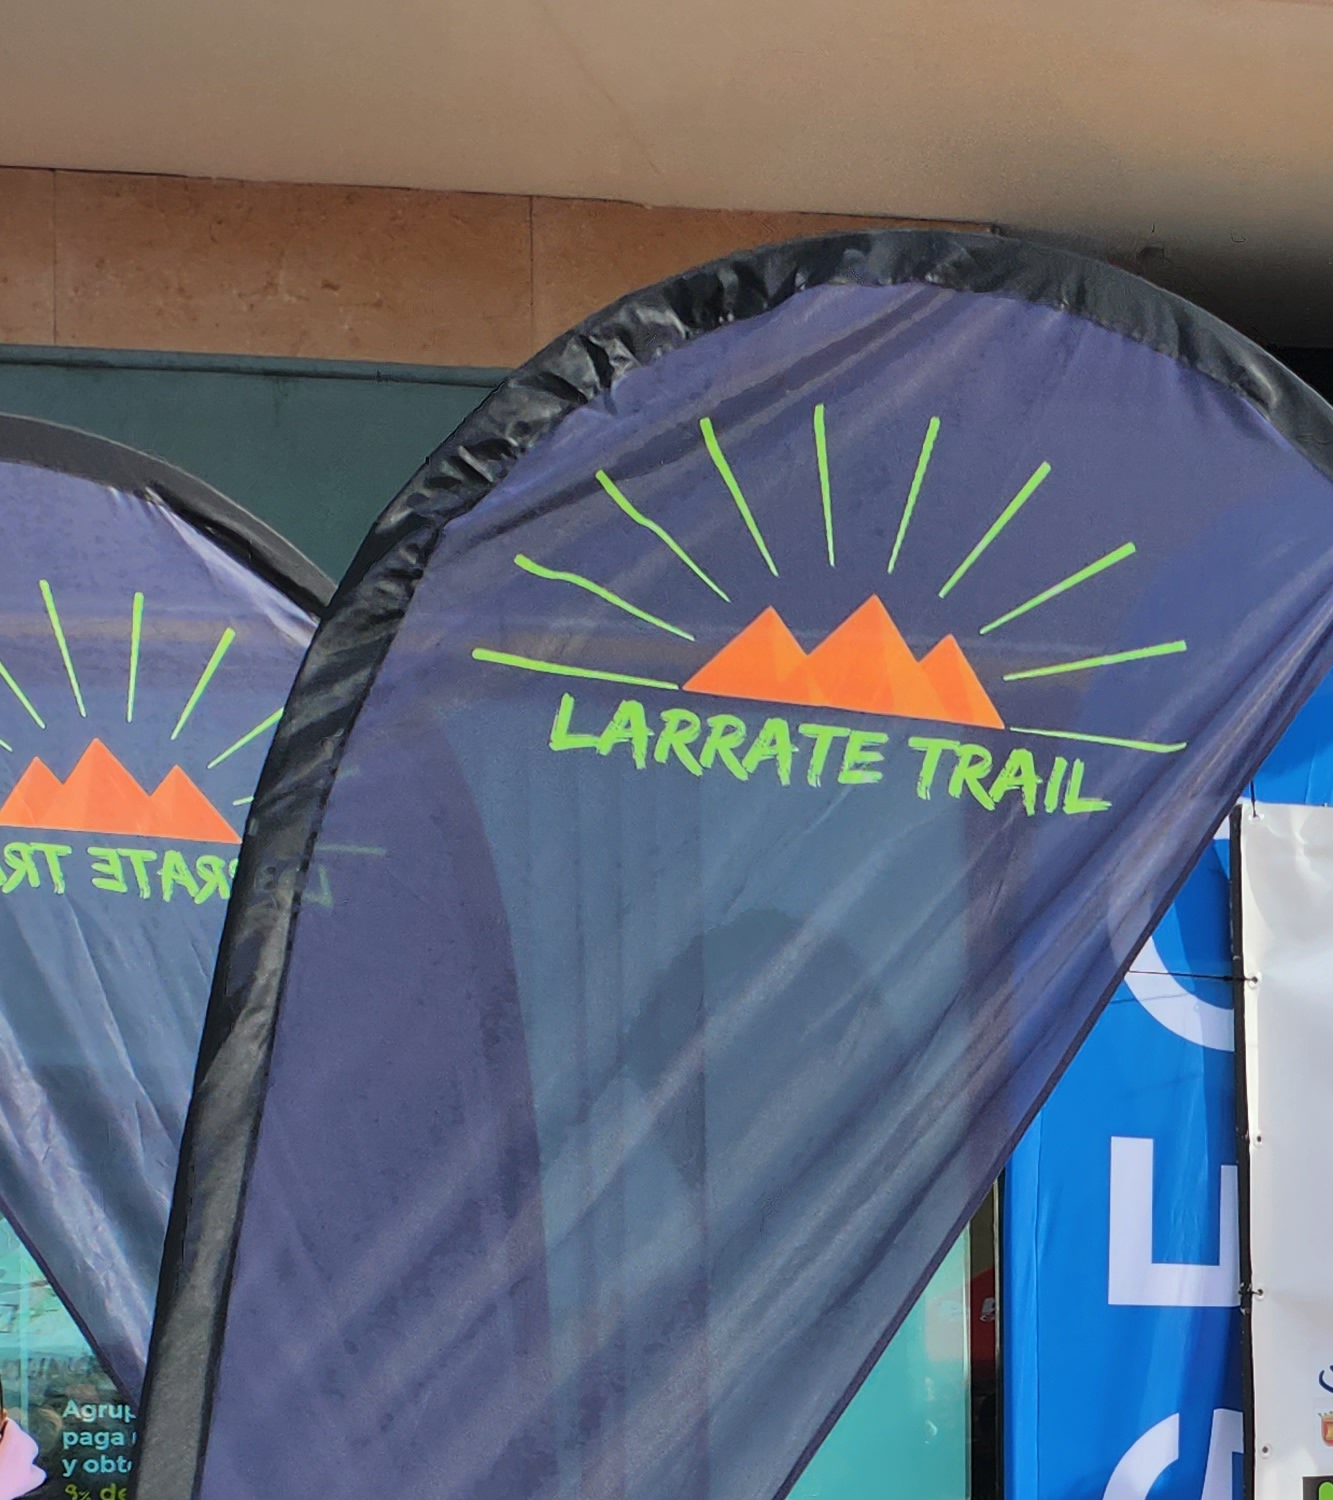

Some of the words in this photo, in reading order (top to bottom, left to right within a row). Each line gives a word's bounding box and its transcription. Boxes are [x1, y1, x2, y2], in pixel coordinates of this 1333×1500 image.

[549, 692, 889, 786] LARRATE
[908, 737, 1111, 816] TRAIL
[62, 1430, 126, 1454] paga
[62, 1457, 77, 1478] y
